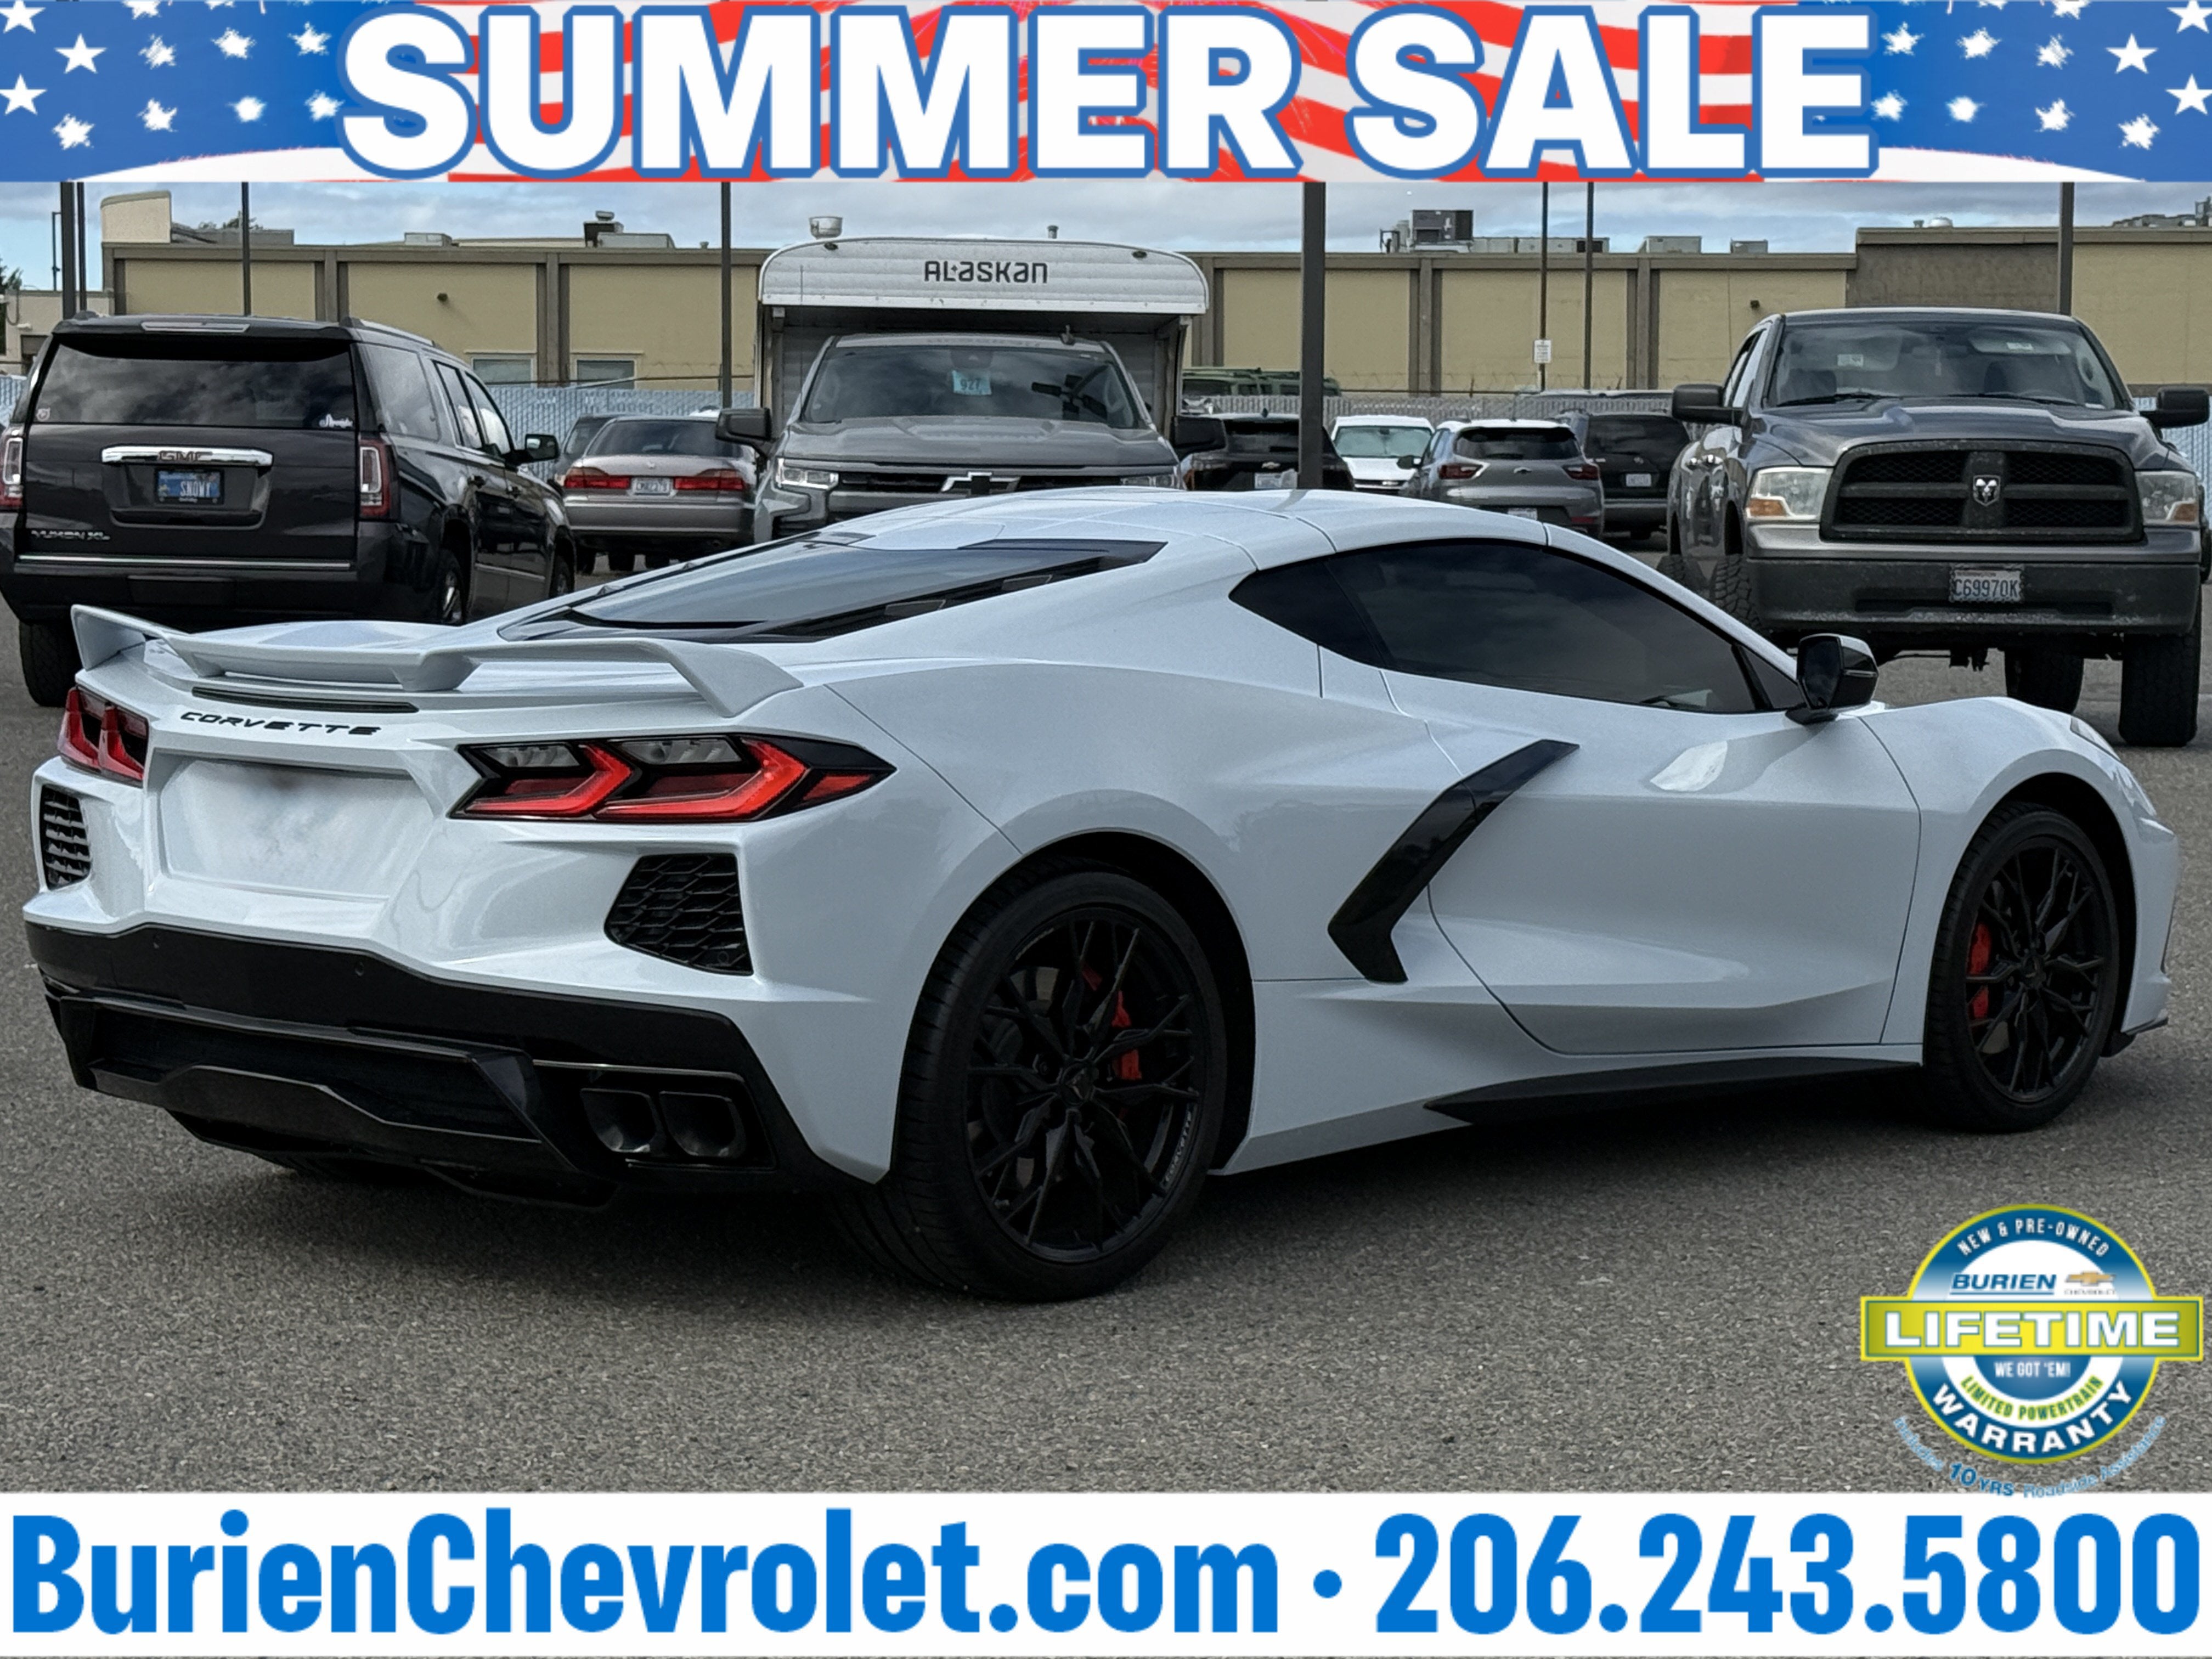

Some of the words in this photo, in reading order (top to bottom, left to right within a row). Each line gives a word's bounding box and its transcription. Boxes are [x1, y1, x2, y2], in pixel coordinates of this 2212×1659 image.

[158, 450, 213, 462] GMC
[1953, 578, 2018, 597] C69970K
[180, 712, 381, 735] CORVETTE
